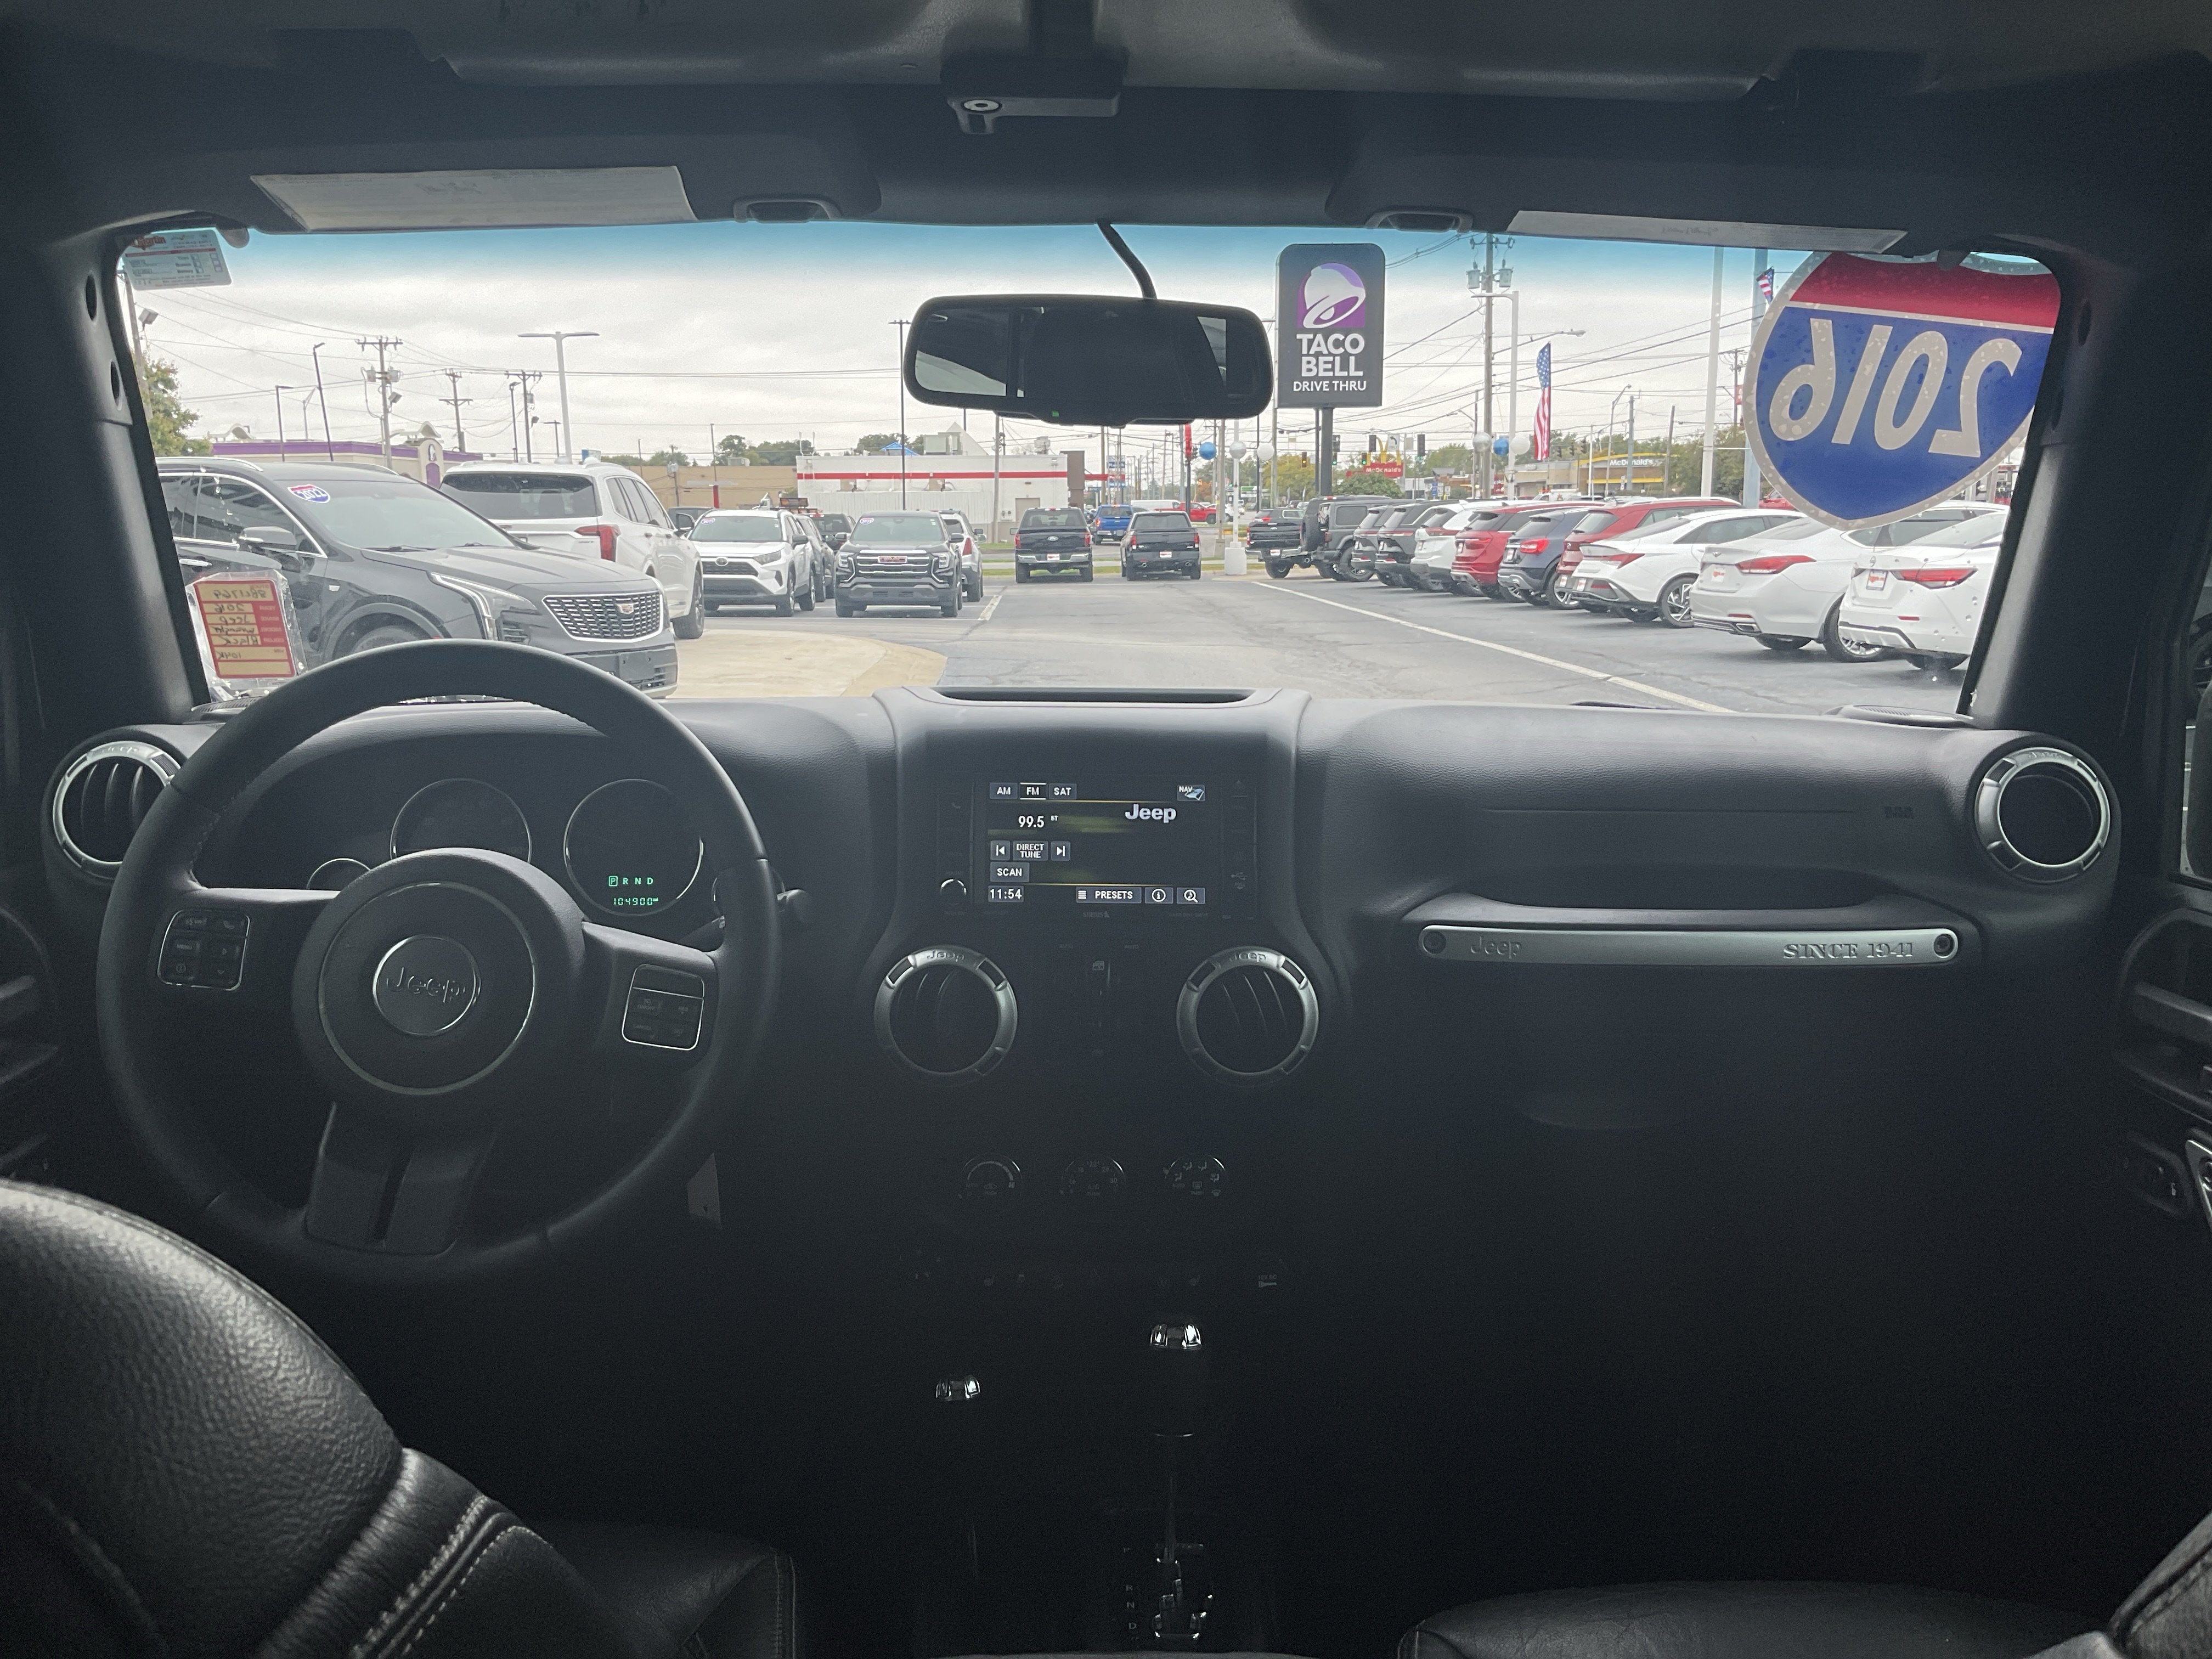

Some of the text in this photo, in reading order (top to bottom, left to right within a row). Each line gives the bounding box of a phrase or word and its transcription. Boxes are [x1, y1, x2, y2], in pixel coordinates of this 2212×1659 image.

[1296, 333, 1365, 354] TACO
[1301, 356, 1363, 377] BELL
[1293, 380, 1367, 392] DRIVE THRU
[996, 786, 1011, 795] AM
[1026, 786, 1040, 796] FM
[1053, 787, 1071, 796] SAT
[1125, 804, 1177, 823] Jeep
[1018, 815, 1045, 828] 99.5
[1016, 843, 1045, 852] DIRECT
[1020, 850, 1041, 859] TUNE
[996, 867, 1022, 877] SCAN
[989, 888, 1022, 900] 11:54
[1094, 890, 1133, 900] PRESETS
[1470, 935, 1522, 960] Jeep
[1782, 942, 1914, 959] SINCE 1941
